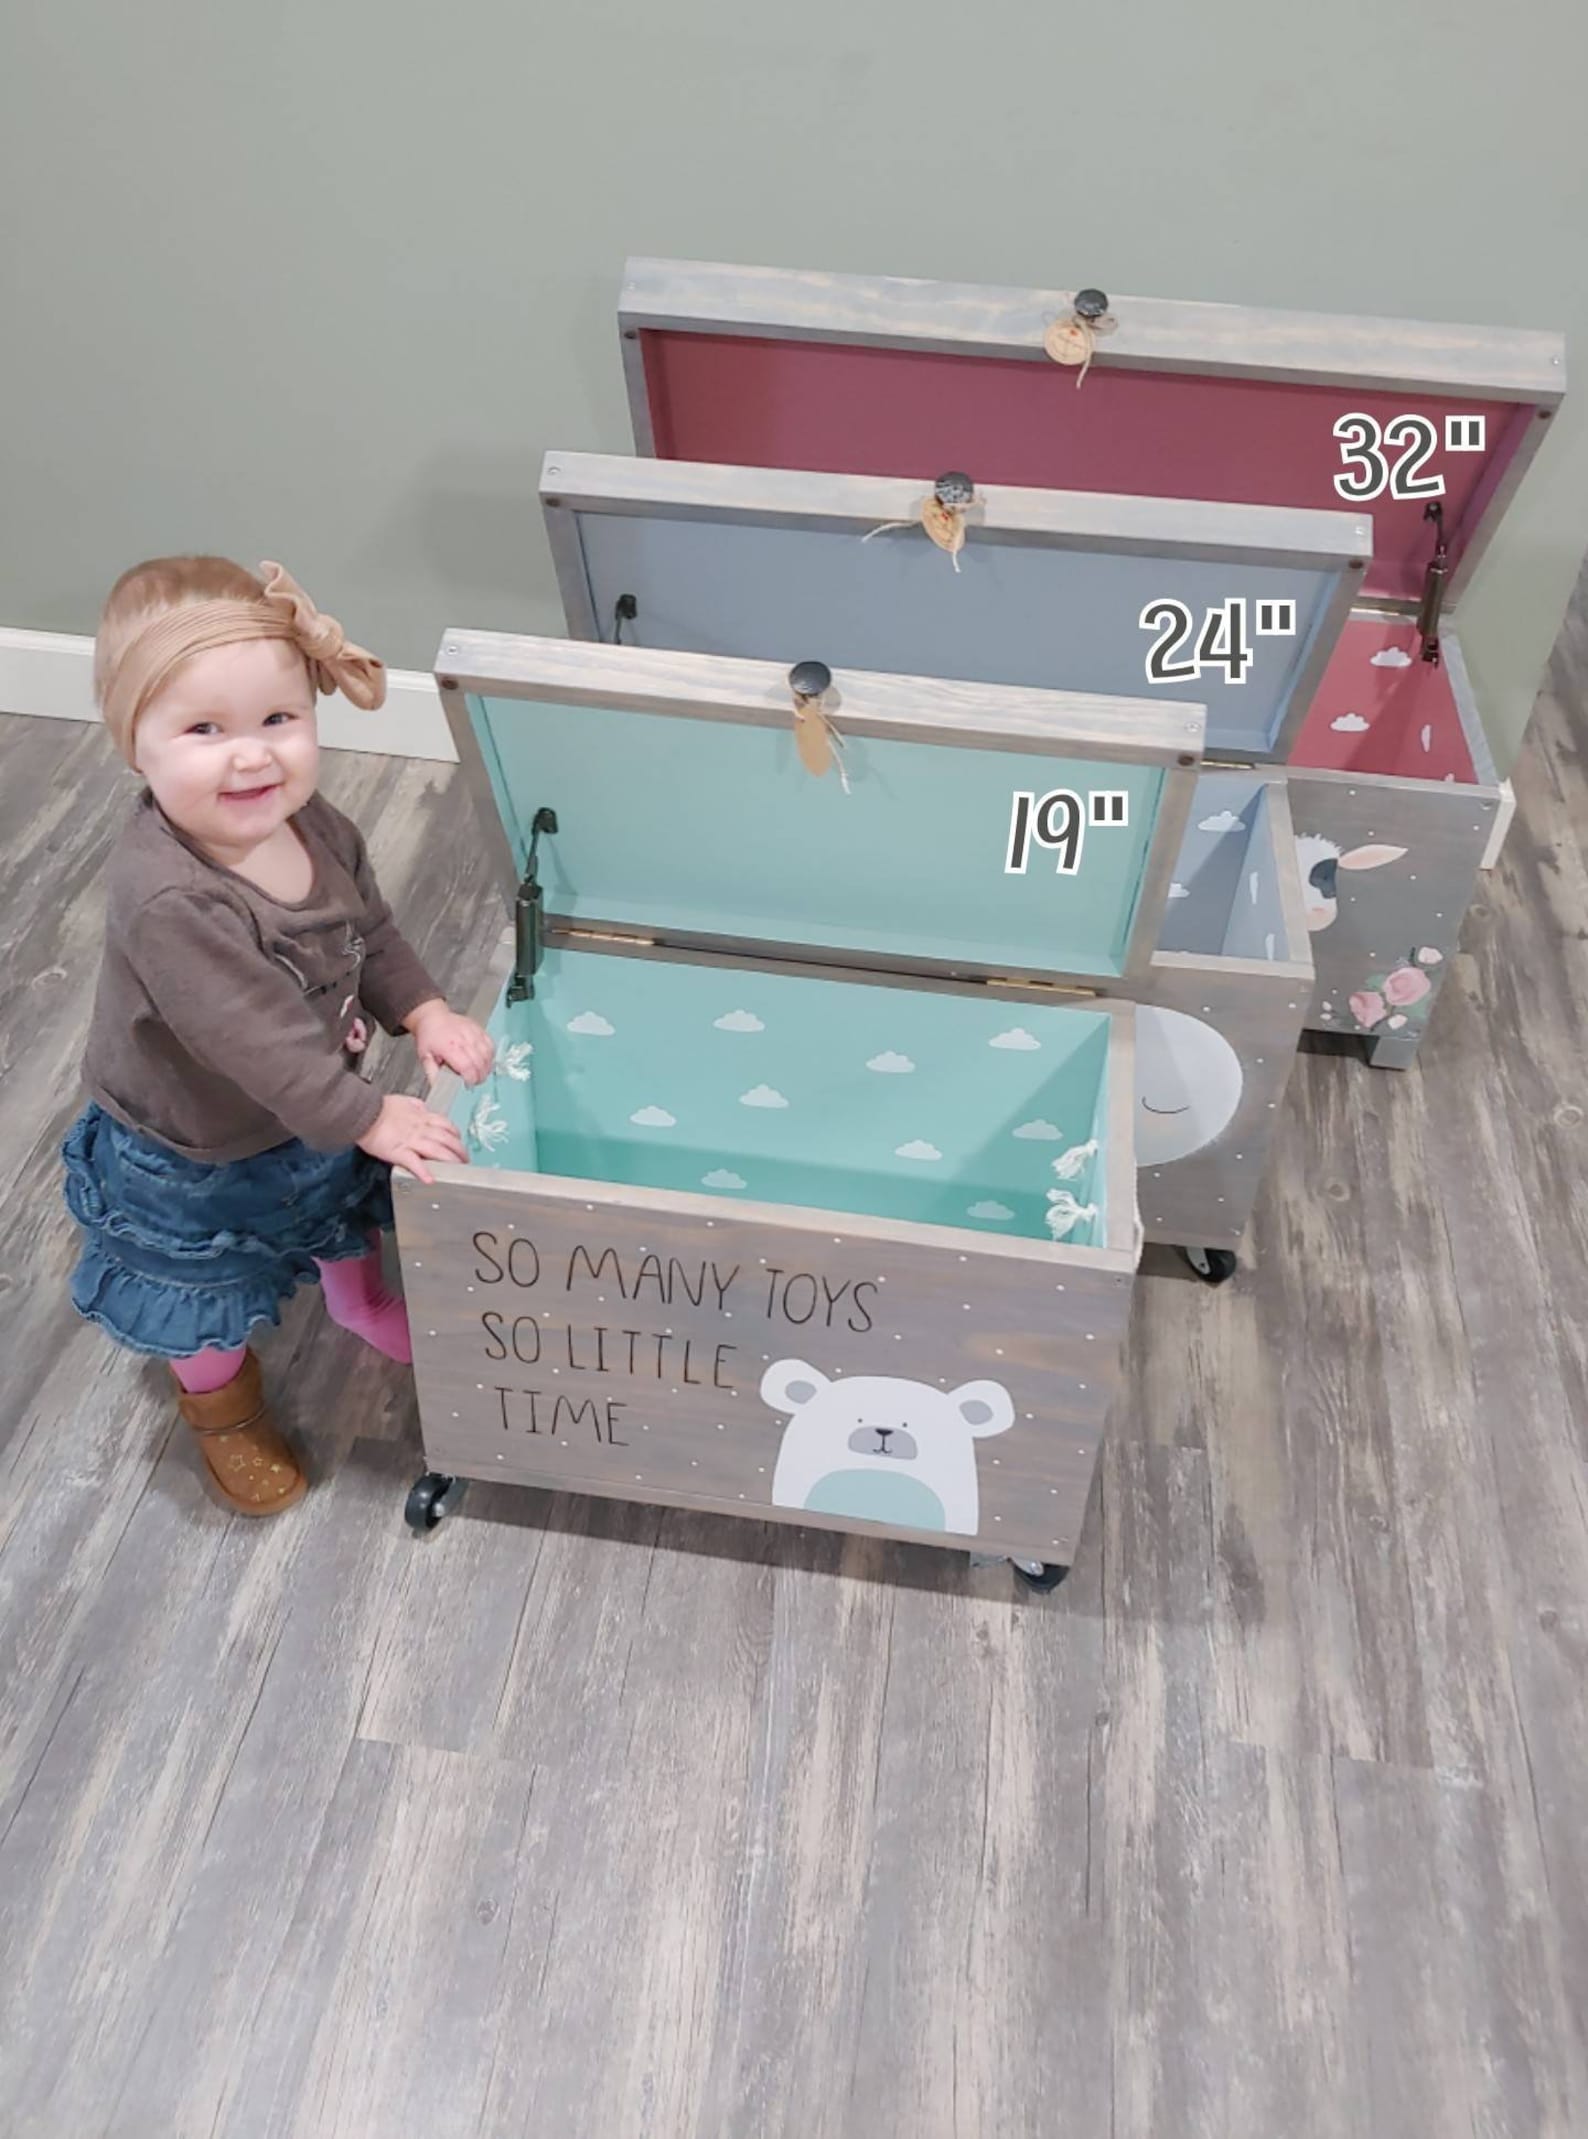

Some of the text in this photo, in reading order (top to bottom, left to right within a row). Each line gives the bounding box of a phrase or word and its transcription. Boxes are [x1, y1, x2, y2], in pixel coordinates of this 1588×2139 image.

[471, 1231, 879, 1333] SO MANY TOYS
[480, 1311, 738, 1389] SO LITTLE
[494, 1386, 630, 1447] TIME
